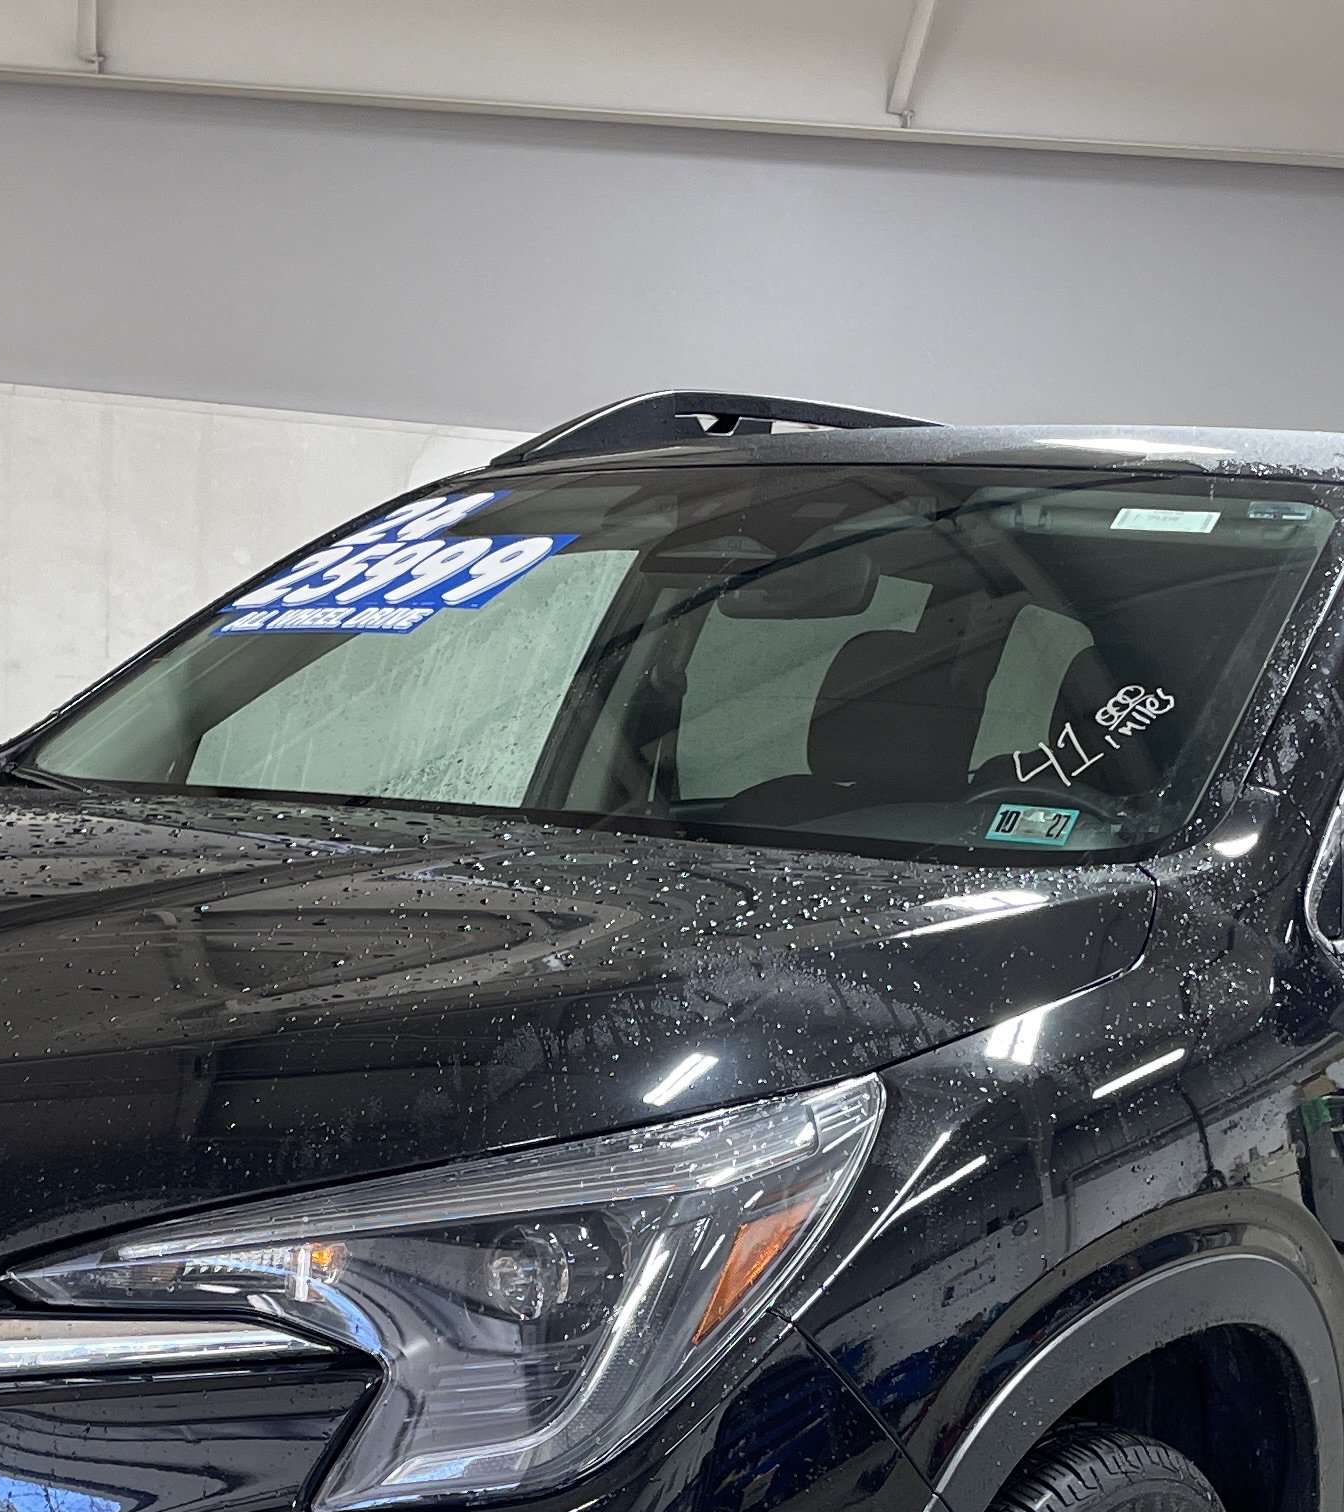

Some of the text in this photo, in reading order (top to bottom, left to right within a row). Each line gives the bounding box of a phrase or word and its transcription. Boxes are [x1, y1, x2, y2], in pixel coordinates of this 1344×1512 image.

[330, 492, 495, 547] 24
[232, 536, 554, 607] 25999
[221, 607, 435, 632] ALL WHEEL DRIVE
[1045, 813, 1072, 840] 27
